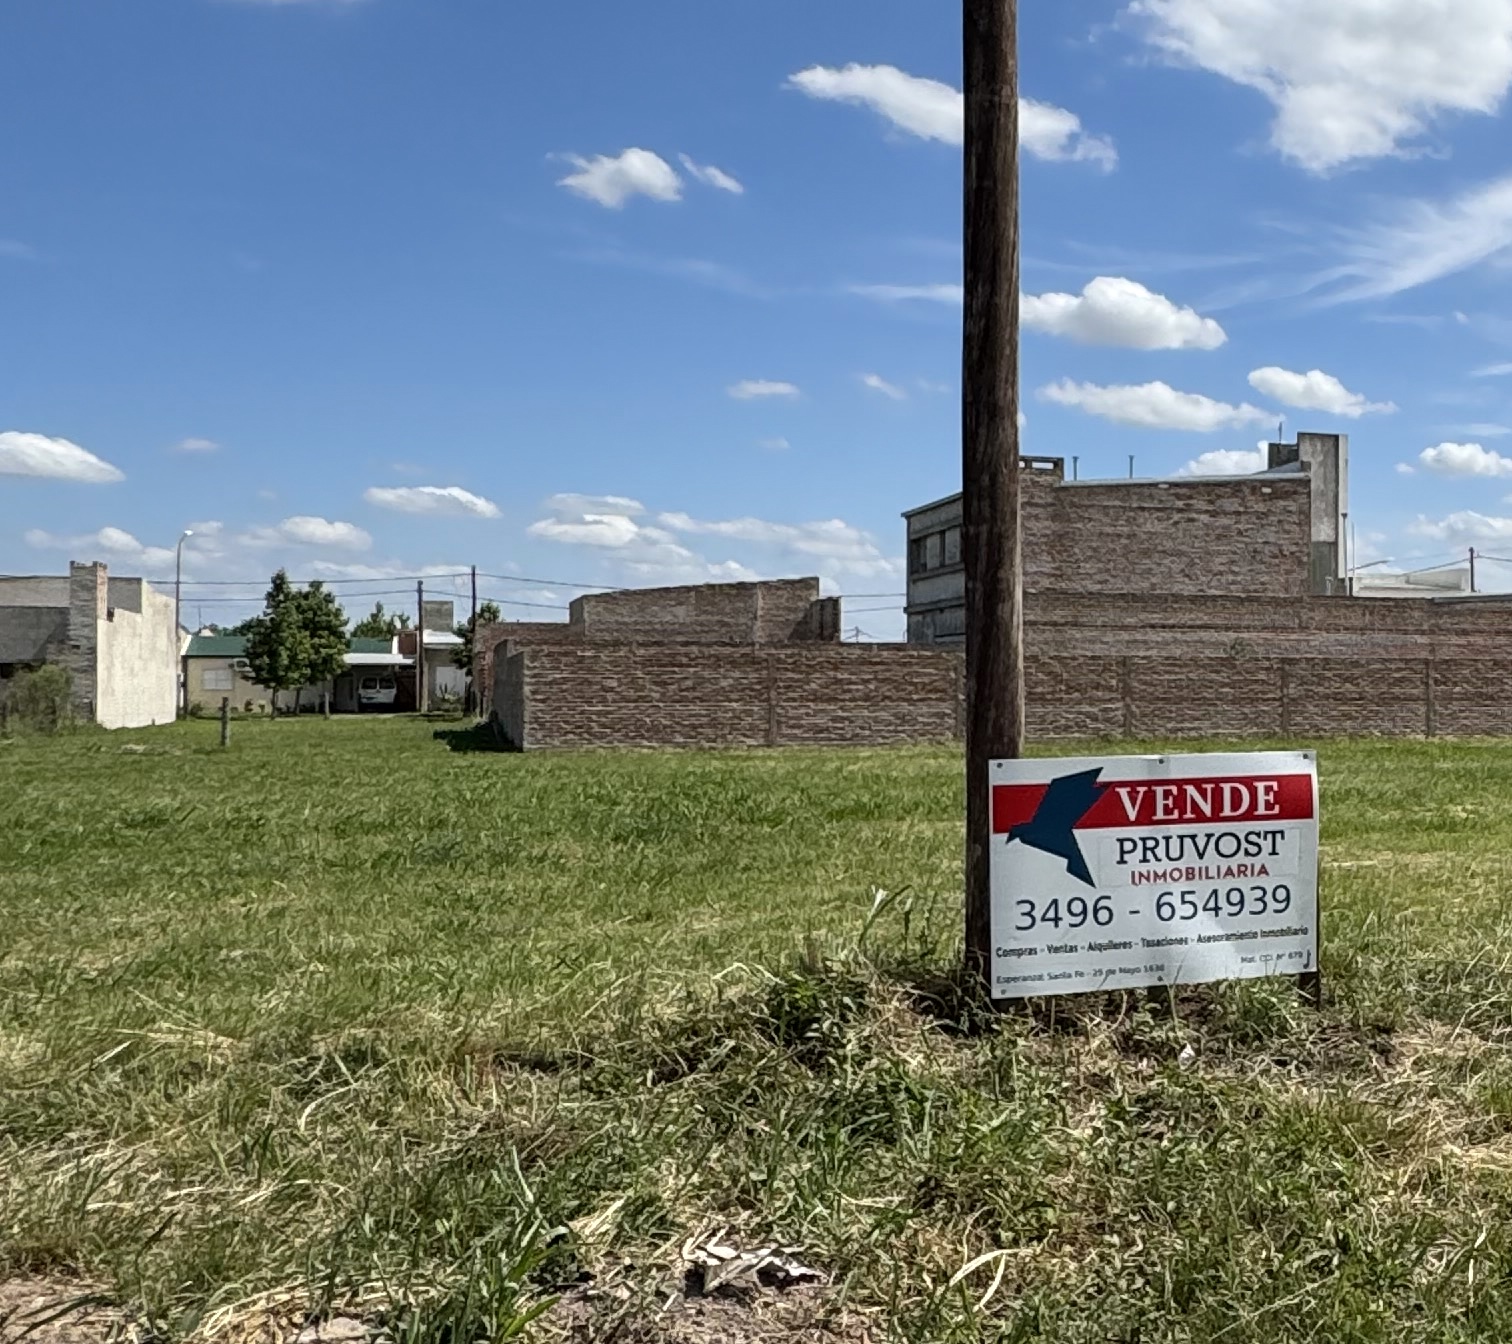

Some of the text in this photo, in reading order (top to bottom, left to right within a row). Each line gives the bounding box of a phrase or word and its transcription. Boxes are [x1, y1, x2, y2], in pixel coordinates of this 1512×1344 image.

[1115, 781, 1280, 821] VENDE
[1116, 830, 1285, 864] PRUVOST
[1131, 863, 1270, 886] INMOBILIARIA
[1015, 895, 1114, 931] 3496
[1155, 884, 1291, 922] 654939
[996, 946, 1038, 959] Compras
[1047, 943, 1078, 954] Ventas
[1141, 936, 1188, 948] Tasaciones
